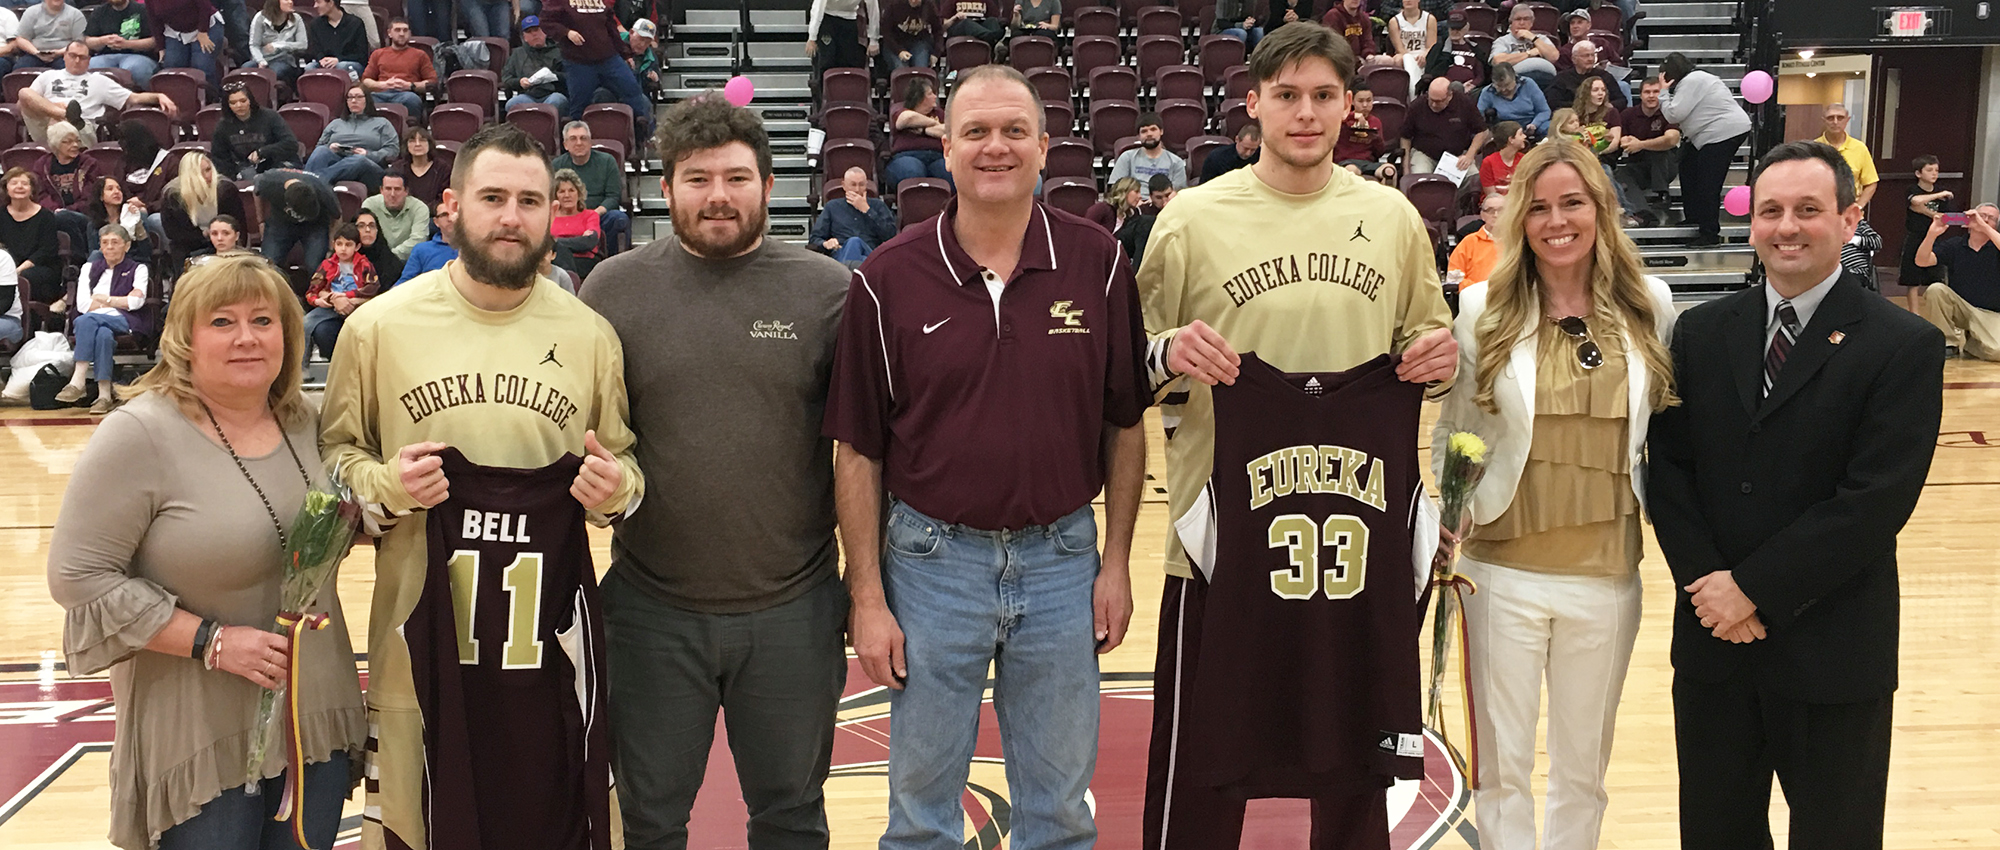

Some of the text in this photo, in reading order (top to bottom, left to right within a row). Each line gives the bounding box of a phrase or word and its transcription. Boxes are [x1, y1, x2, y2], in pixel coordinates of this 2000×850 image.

[1400, 30, 1425, 39] EUREKA
[1899, 13, 1921, 30] EXIT
[1407, 39, 1421, 51] 42
[1222, 252, 1385, 308] EUREKA COLLEGE
[750, 331, 798, 340] VANILLA
[399, 373, 578, 431] EUREKA COLLEGE
[1247, 445, 1387, 513] EUREKA
[462, 509, 531, 543] BELL
[1268, 514, 1370, 600] 33
[447, 549, 544, 670] 11
